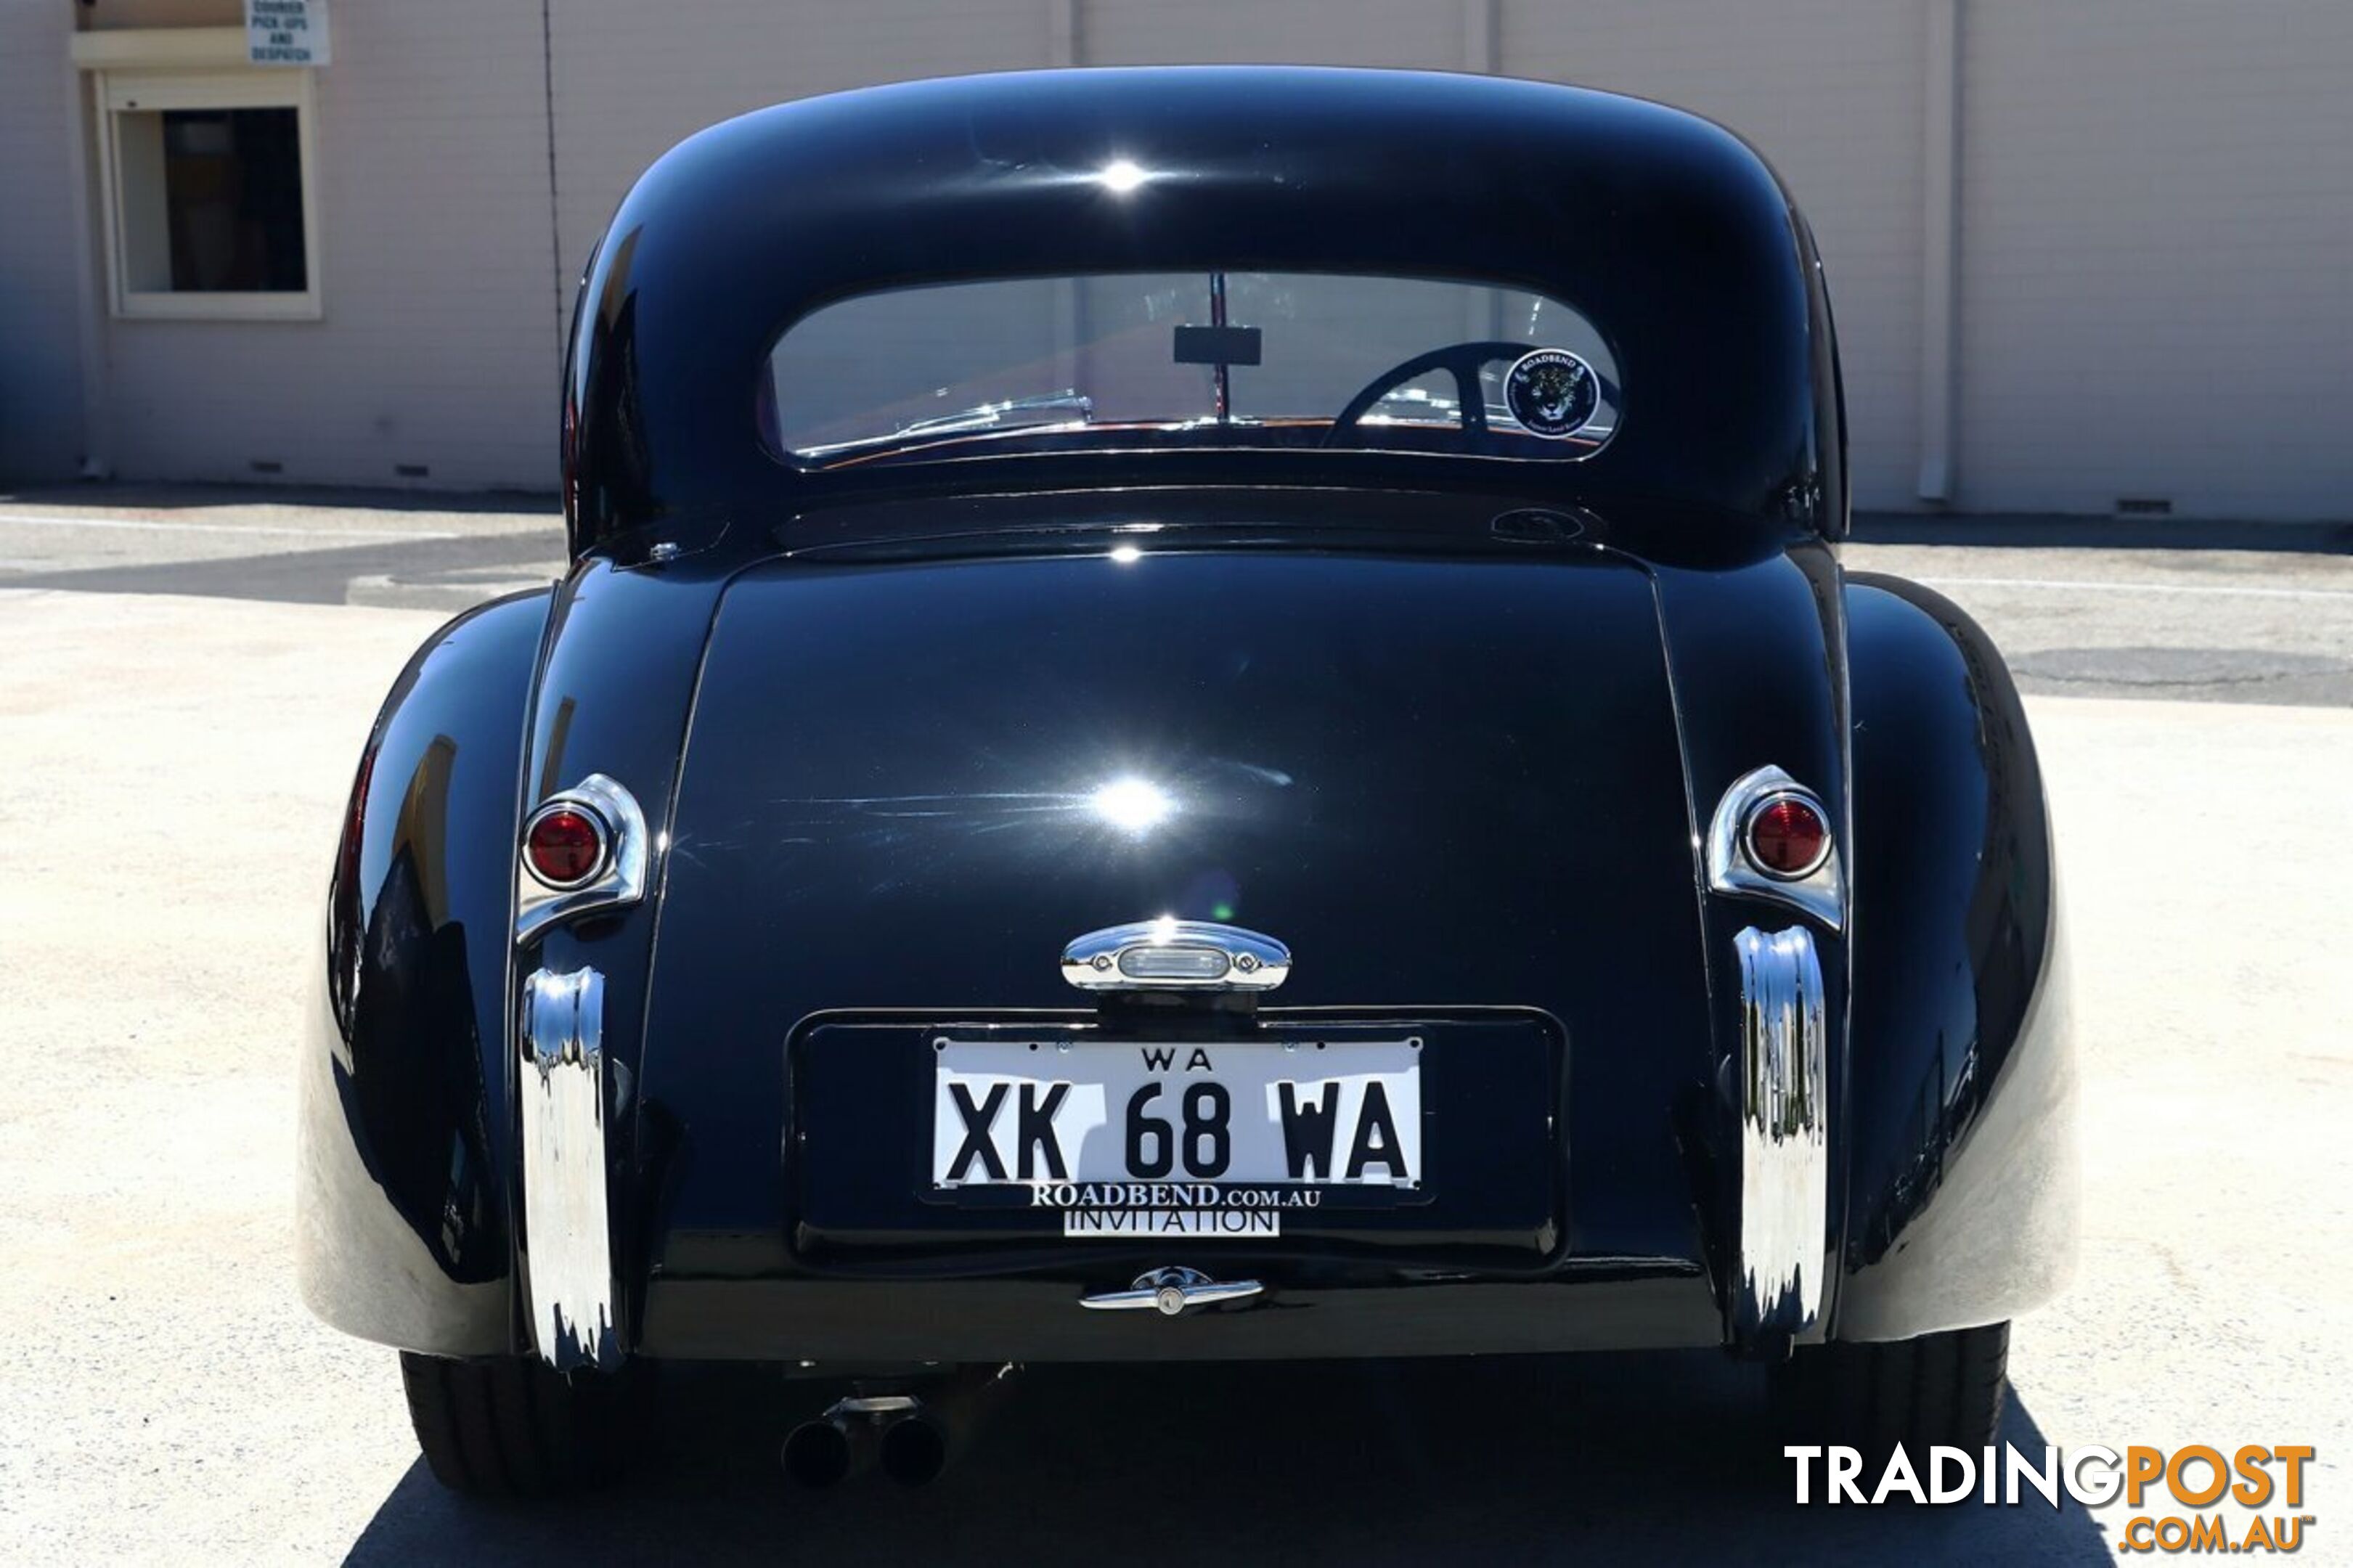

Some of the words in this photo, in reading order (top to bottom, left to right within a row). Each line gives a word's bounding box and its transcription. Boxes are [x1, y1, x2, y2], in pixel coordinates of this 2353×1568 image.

[269, 33, 293, 44] AND
[1522, 355, 1576, 370] ROADBEND
[947, 1082, 1072, 1180] XK
[1125, 1082, 1231, 1179] 68
[1278, 1082, 1408, 1179] WA
[1031, 1184, 1321, 1208] ROADBEND.COM.AU
